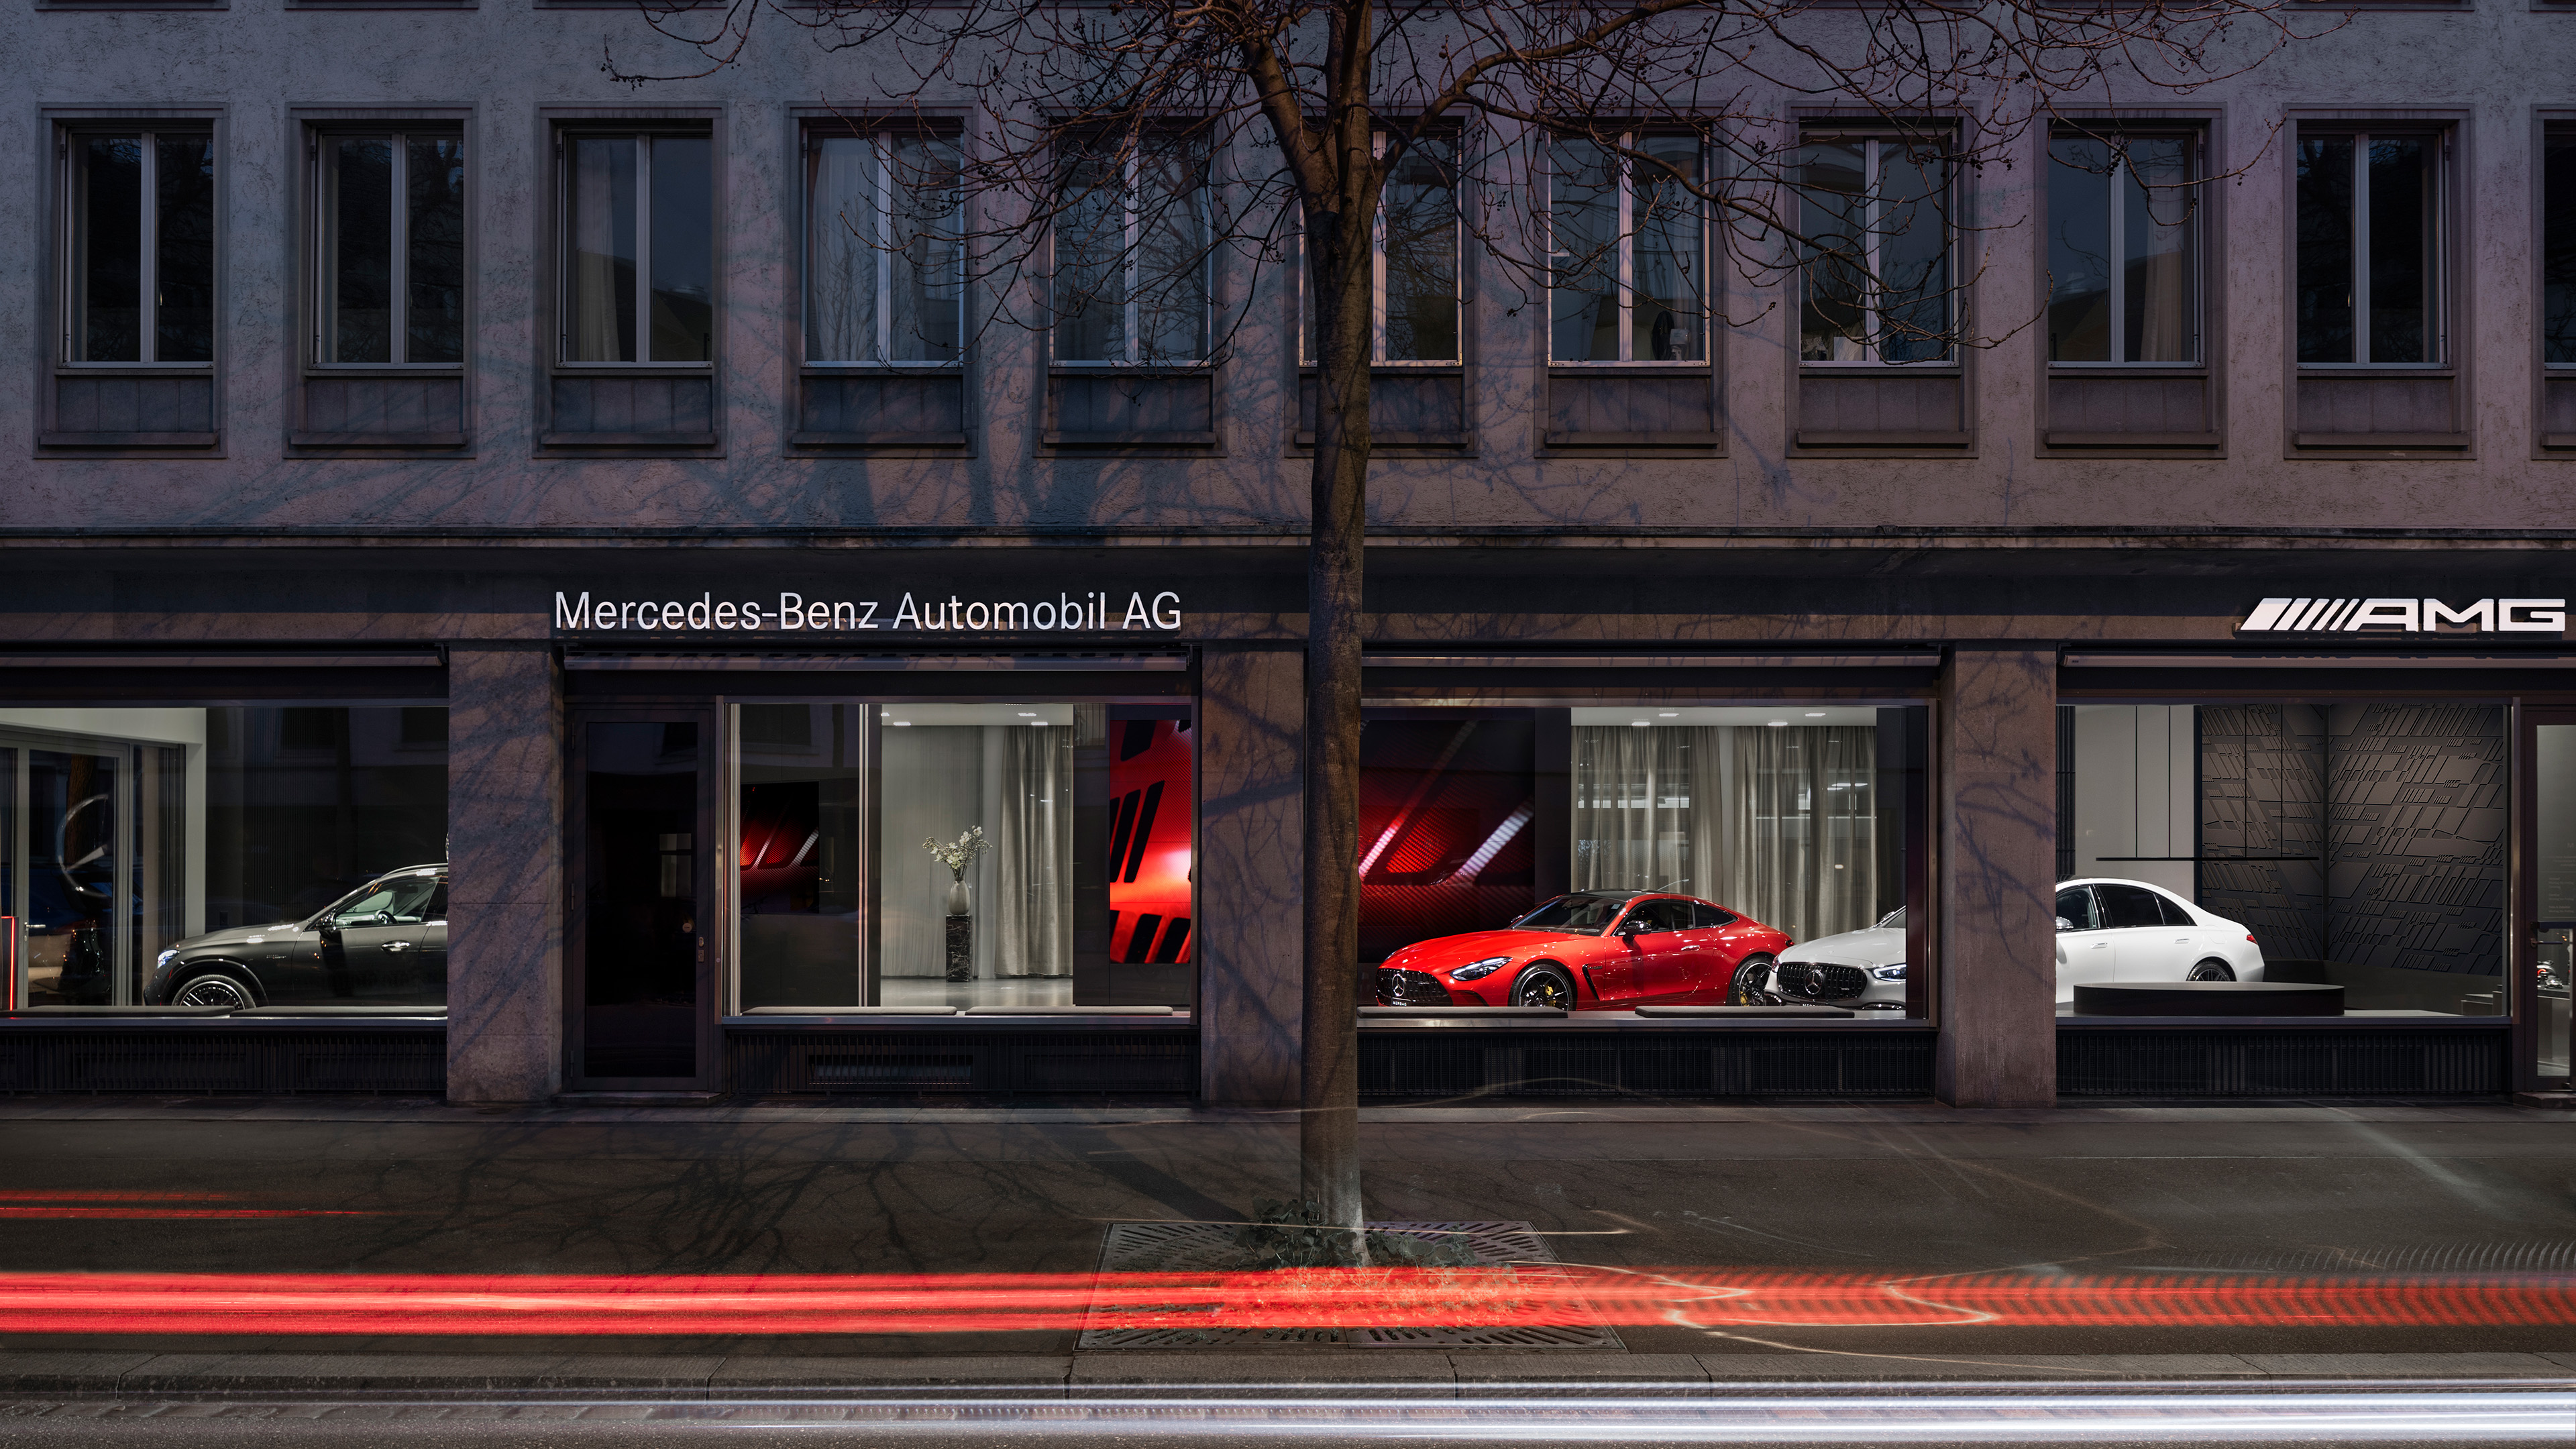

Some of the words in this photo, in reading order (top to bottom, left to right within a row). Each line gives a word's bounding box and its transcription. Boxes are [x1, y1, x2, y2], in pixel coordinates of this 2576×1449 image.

[555, 591, 879, 629] Mercedes-Benz
[892, 592, 1106, 630] Automobil
[1122, 591, 1181, 629] AG
[2343, 598, 2566, 632] AMG
